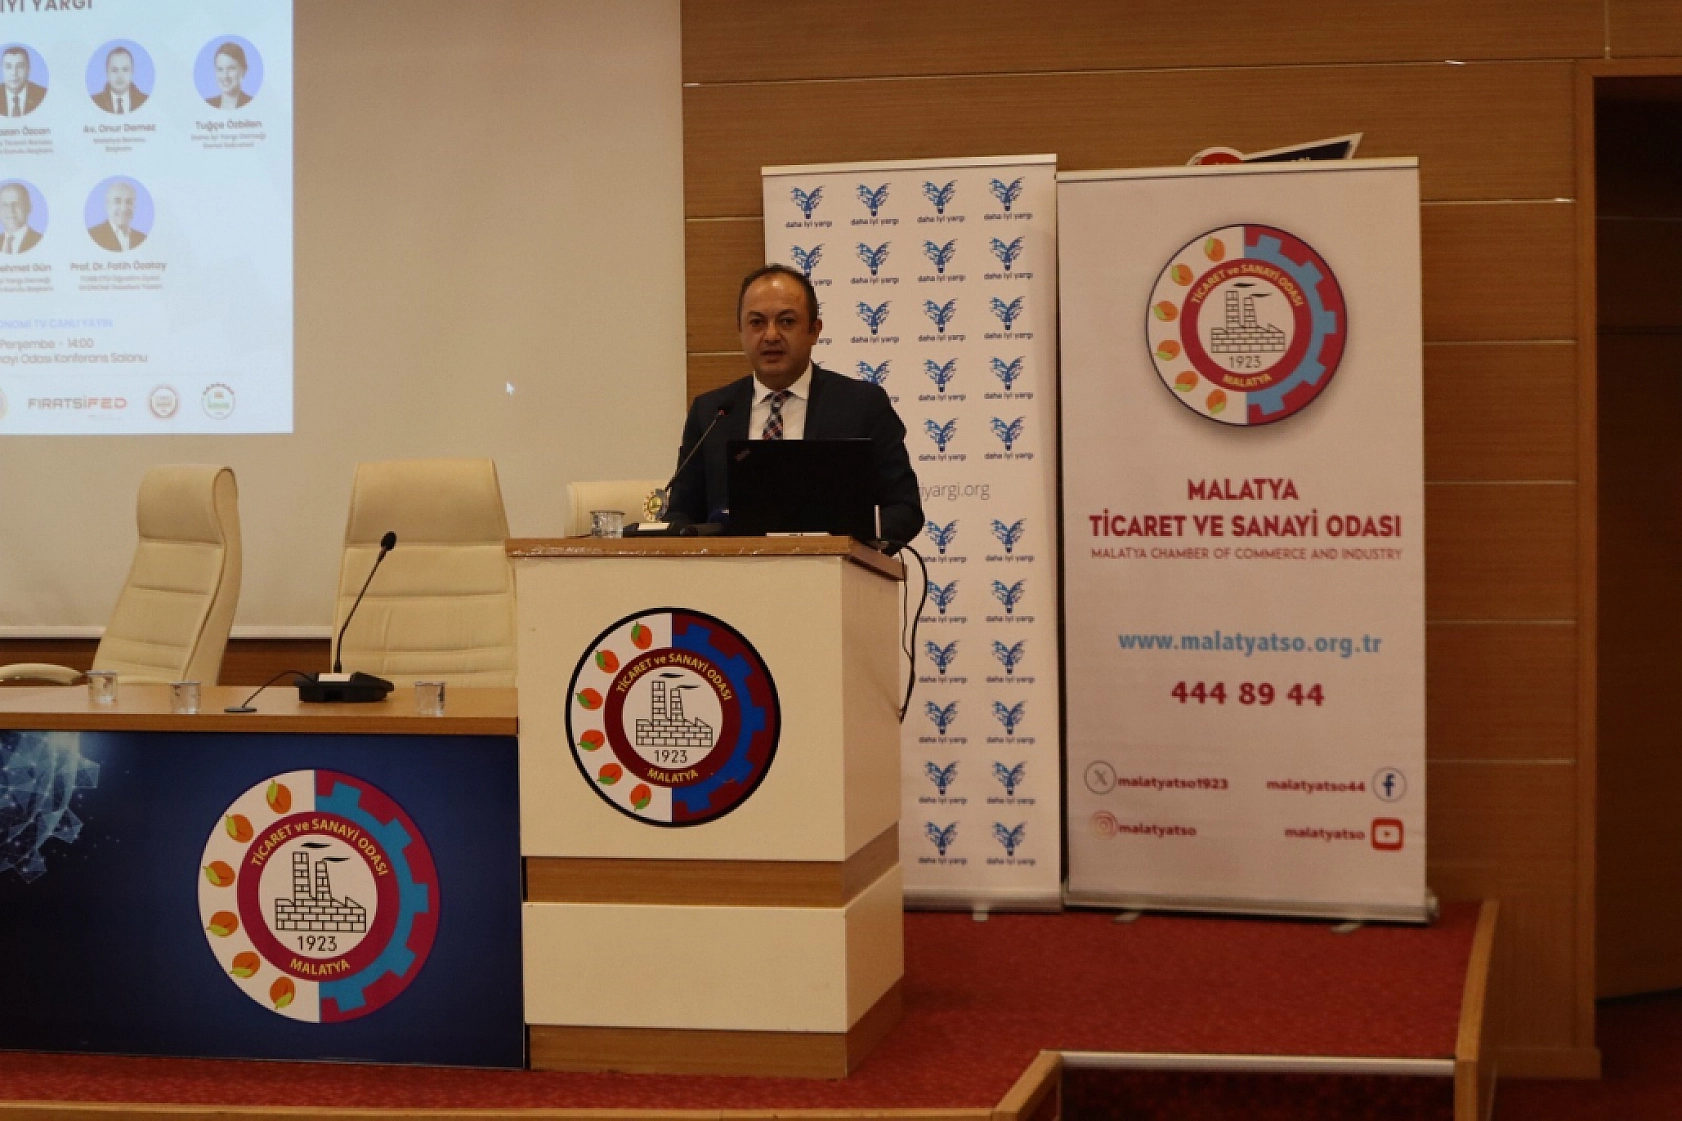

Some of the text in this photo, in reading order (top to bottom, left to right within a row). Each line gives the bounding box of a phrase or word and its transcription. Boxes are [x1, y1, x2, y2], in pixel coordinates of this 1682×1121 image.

[1228, 355, 1262, 369] 1923
[1222, 373, 1272, 386] MALATYA
[920, 482, 990, 502] iyargi.org
[1187, 478, 1299, 501] MALATYA
[1089, 508, 1401, 538] TİCARET VE SANAYİ ODASI
[1091, 547, 1402, 560] MALATYA CHAMBER OF COMMERCE AND INDUSTRY
[1118, 630, 1382, 659] www.malatyatso.org.tr
[616, 653, 732, 701] TİCARET ve SANAYİ ODASI
[1171, 681, 1325, 707] 444 89 44
[654, 750, 688, 764] 1923
[647, 768, 698, 783] MALATYA
[1118, 776, 1229, 791] malatyatso1923
[1267, 779, 1366, 794] malatyatso44
[1119, 824, 1197, 838] malatyatso
[1285, 827, 1366, 842] malatyatso
[251, 818, 389, 876] TİCARET ve SANAYİ ODASI
[297, 935, 338, 951] 1923
[289, 958, 350, 976] MALATYA
